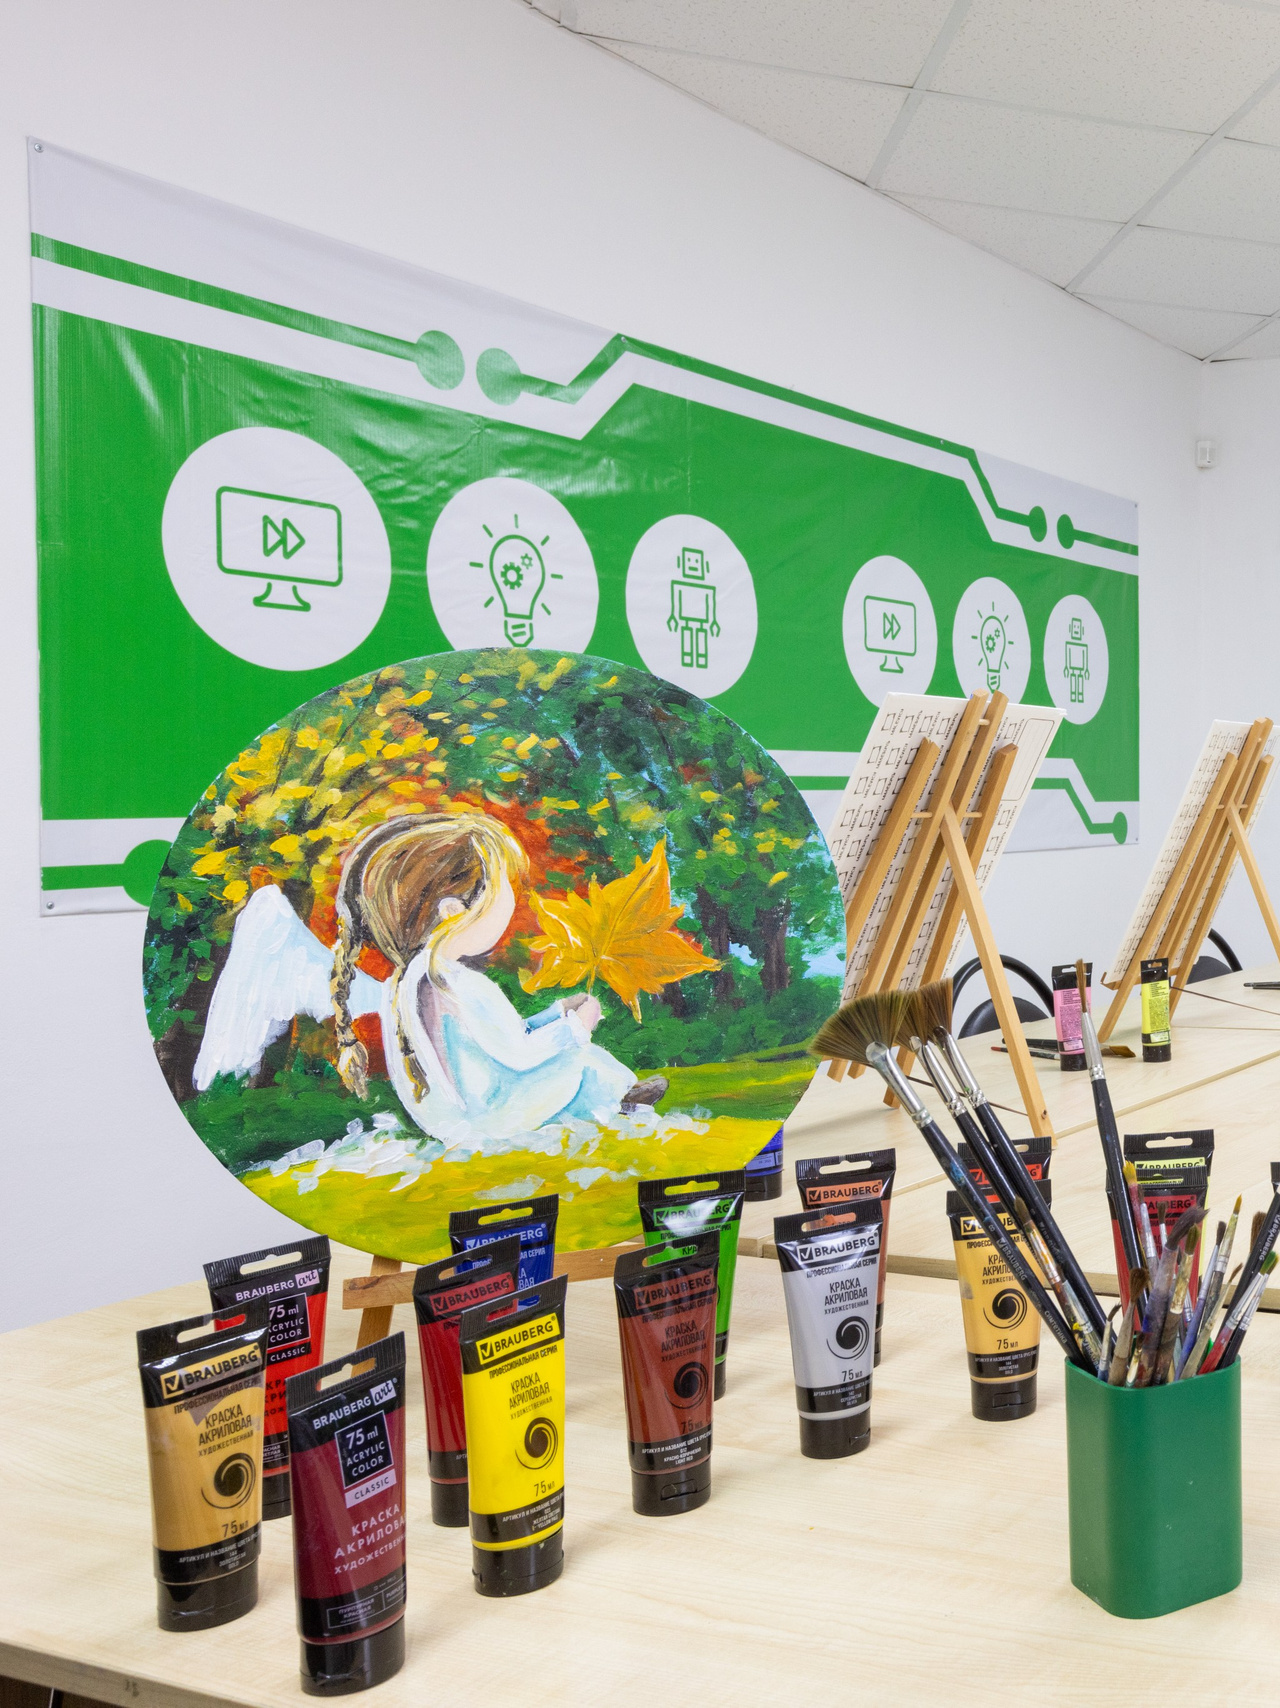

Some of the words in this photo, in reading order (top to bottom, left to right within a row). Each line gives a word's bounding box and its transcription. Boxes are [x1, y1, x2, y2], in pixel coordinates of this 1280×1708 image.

[823, 1184, 879, 1199] BRAUBERG
[528, 1248, 546, 1258] СЕРИЯ
[814, 1236, 875, 1258] BRAUBERG
[862, 1257, 877, 1267] СЕРИЯ
[1002, 1246, 1028, 1281] BRAUBERG
[236, 1280, 294, 1301] BRAUBERG
[449, 1279, 510, 1306] BRAUBERG
[651, 1275, 710, 1300] BRAUBERG
[824, 1287, 868, 1306] АКРИЛОВАЯ
[830, 1278, 860, 1294] КРАСКА
[269, 1304, 286, 1320] 75
[288, 1304, 299, 1315] ml
[824, 1300, 869, 1315] ХУДОЖЕСТВЕННАЯ
[270, 1329, 302, 1343] COLOR
[494, 1321, 554, 1352] BRAUBERG
[665, 1320, 697, 1339] КРАСКА
[662, 1330, 705, 1352] АКРИЛОВАЯ
[997, 1339, 1008, 1350] 75
[270, 1346, 305, 1362] CLASSIC
[489, 1352, 539, 1379] ПРОФЕССИОНАЛЬНАЯ
[540, 1344, 558, 1358] СЕРИЯ
[185, 1350, 258, 1385] BRAUBERG
[842, 1369, 854, 1382] 75
[511, 1372, 540, 1394] КРАСКА
[313, 1396, 371, 1430] BRAUBERG
[374, 1382, 392, 1404] art
[509, 1382, 550, 1410] АКРИЛОВАЯ
[205, 1404, 243, 1429] КРАСКА
[681, 1419, 693, 1434] 75
[199, 1415, 252, 1446] АКРИЛОВАЯ
[346, 1428, 364, 1450] 75
[367, 1426, 378, 1440] ml
[198, 1430, 254, 1457] ХУДОЖЕСТВЕННАЯ
[346, 1441, 385, 1466] ACRYLIC
[352, 1455, 384, 1476] COLOR
[354, 1477, 389, 1500] CLASSIC
[534, 1480, 546, 1496] 75
[352, 1504, 400, 1536] КРАСКА
[502, 1513, 524, 1522] АРТИКУЛ
[222, 1520, 238, 1537] 75
